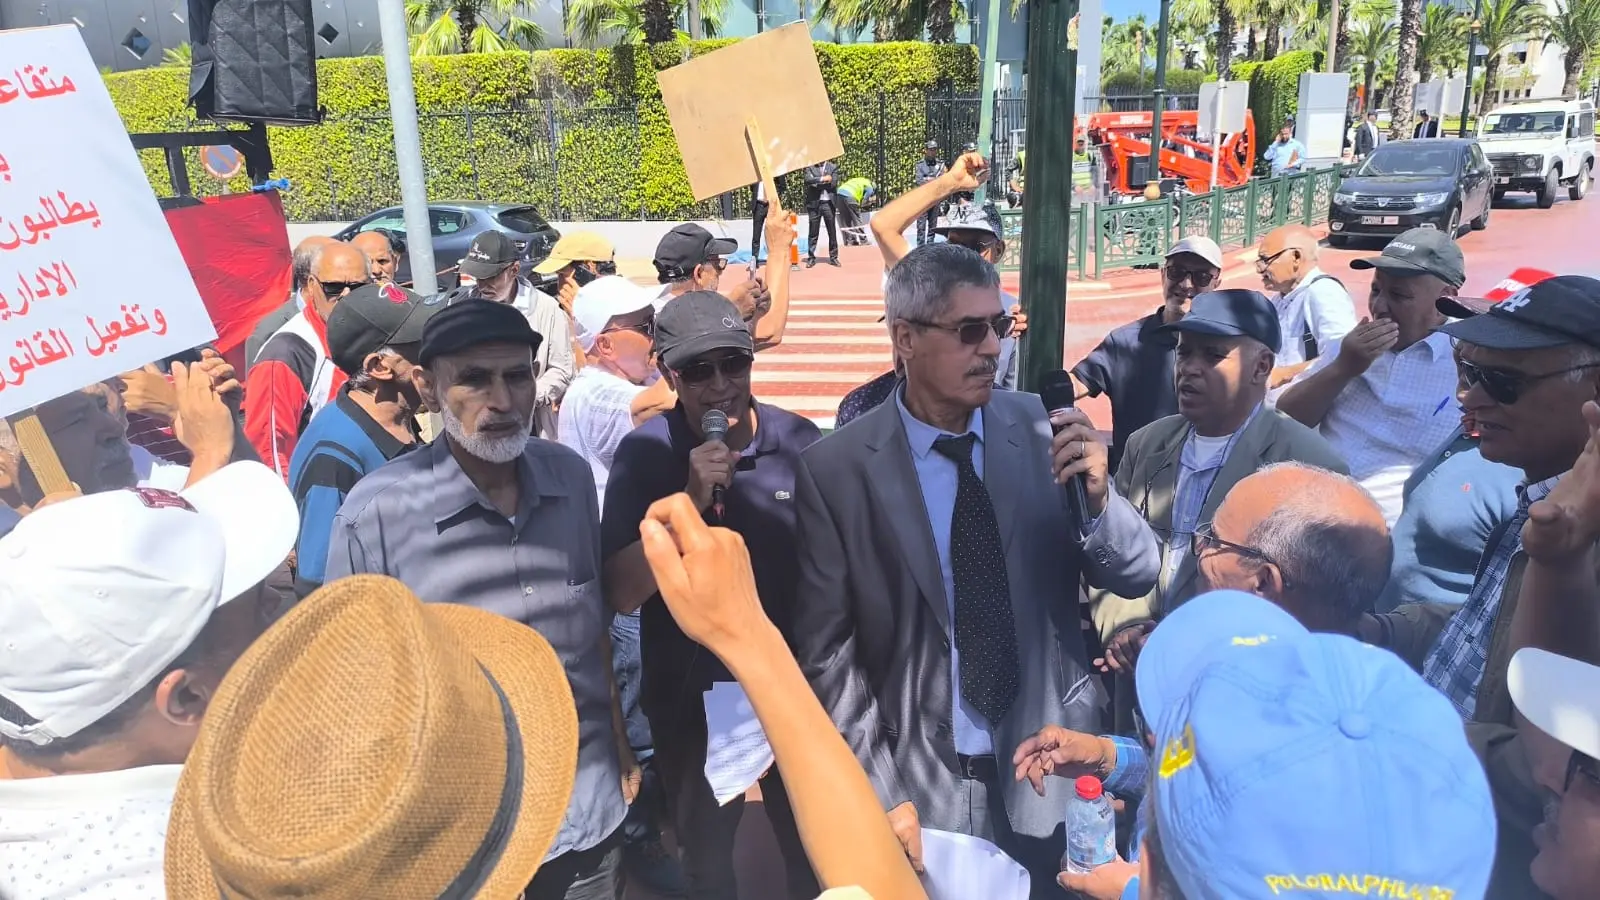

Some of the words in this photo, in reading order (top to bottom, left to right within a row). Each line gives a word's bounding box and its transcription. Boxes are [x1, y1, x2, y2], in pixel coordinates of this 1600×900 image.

[0, 64, 77, 105] متقاع
[0, 260, 77, 321] الاداري
[86, 303, 168, 357] وتفعيل
